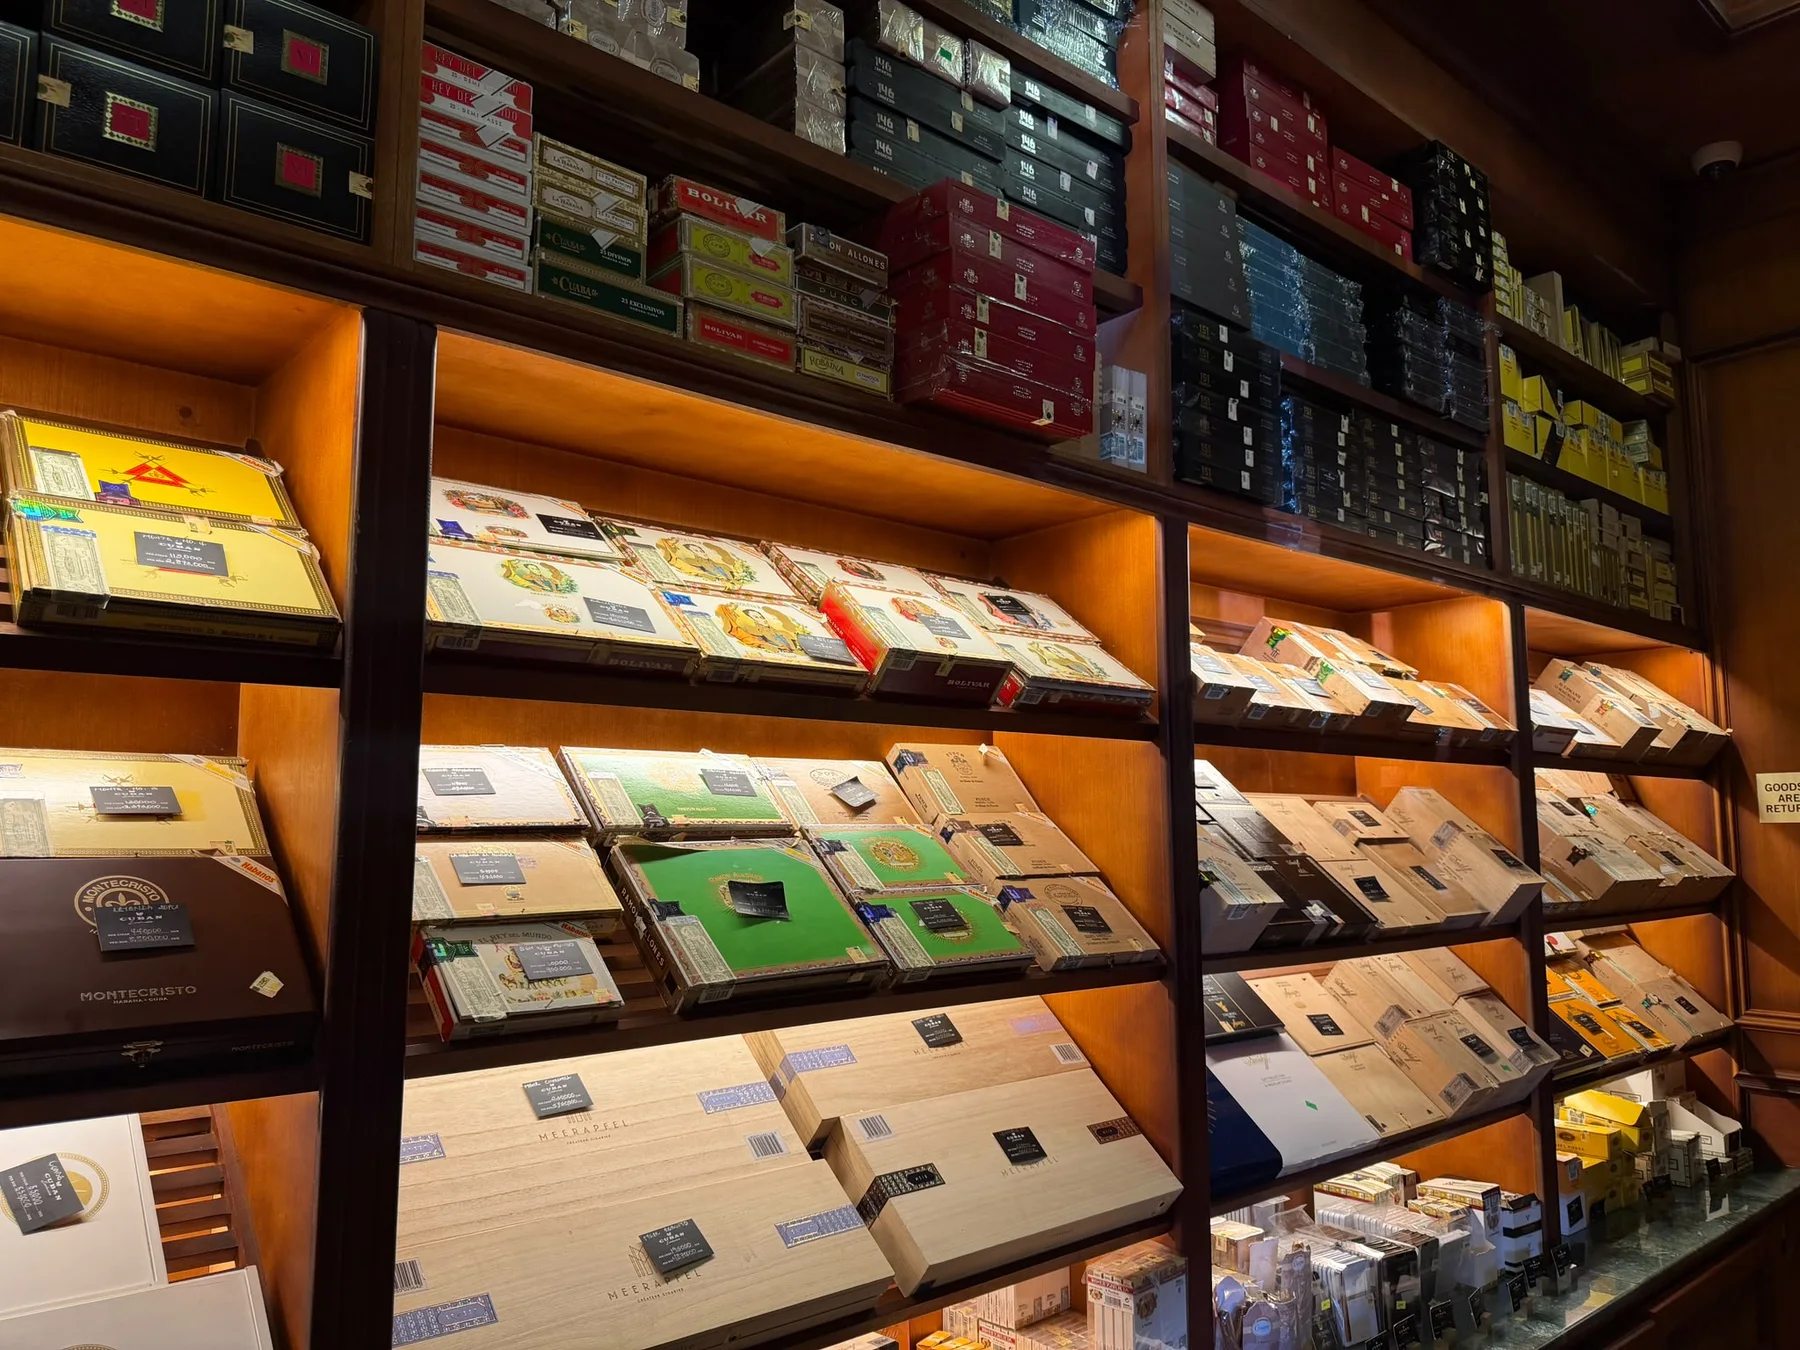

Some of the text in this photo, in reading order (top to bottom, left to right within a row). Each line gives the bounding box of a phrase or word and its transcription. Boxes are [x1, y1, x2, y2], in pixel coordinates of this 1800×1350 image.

[435, 51, 477, 77] REY DEL
[431, 80, 451, 96] REY
[1025, 81, 1040, 96] 146
[1019, 109, 1034, 124] 146
[1021, 134, 1036, 149] 146
[1020, 160, 1035, 176] 146
[1023, 186, 1037, 201] 146
[810, 233, 885, 270] RON ALLONES
[559, 276, 593, 297] CUABA
[629, 299, 665, 317] EXCLUSIVOS
[704, 324, 743, 340] BOLIVAR
[946, 679, 990, 689] BOLIVAR
[1778, 794, 1800, 803] ARE
[241, 861, 276, 884] Habanos
[82, 879, 161, 904] MONTECRISTO
[490, 932, 507, 944] REY
[522, 931, 552, 940] MUNDO
[561, 922, 593, 940] Habanos
[643, 930, 664, 966] LLONES
[80, 985, 197, 1002] MONTECRISTO
[541, 1084, 568, 1093] CUBAN
[538, 1119, 629, 1141] MEERAPFEL
[44, 1173, 62, 1201] CUBAN
[658, 1232, 685, 1244] CUBAN
[607, 1269, 702, 1301] MEERAPFEL
